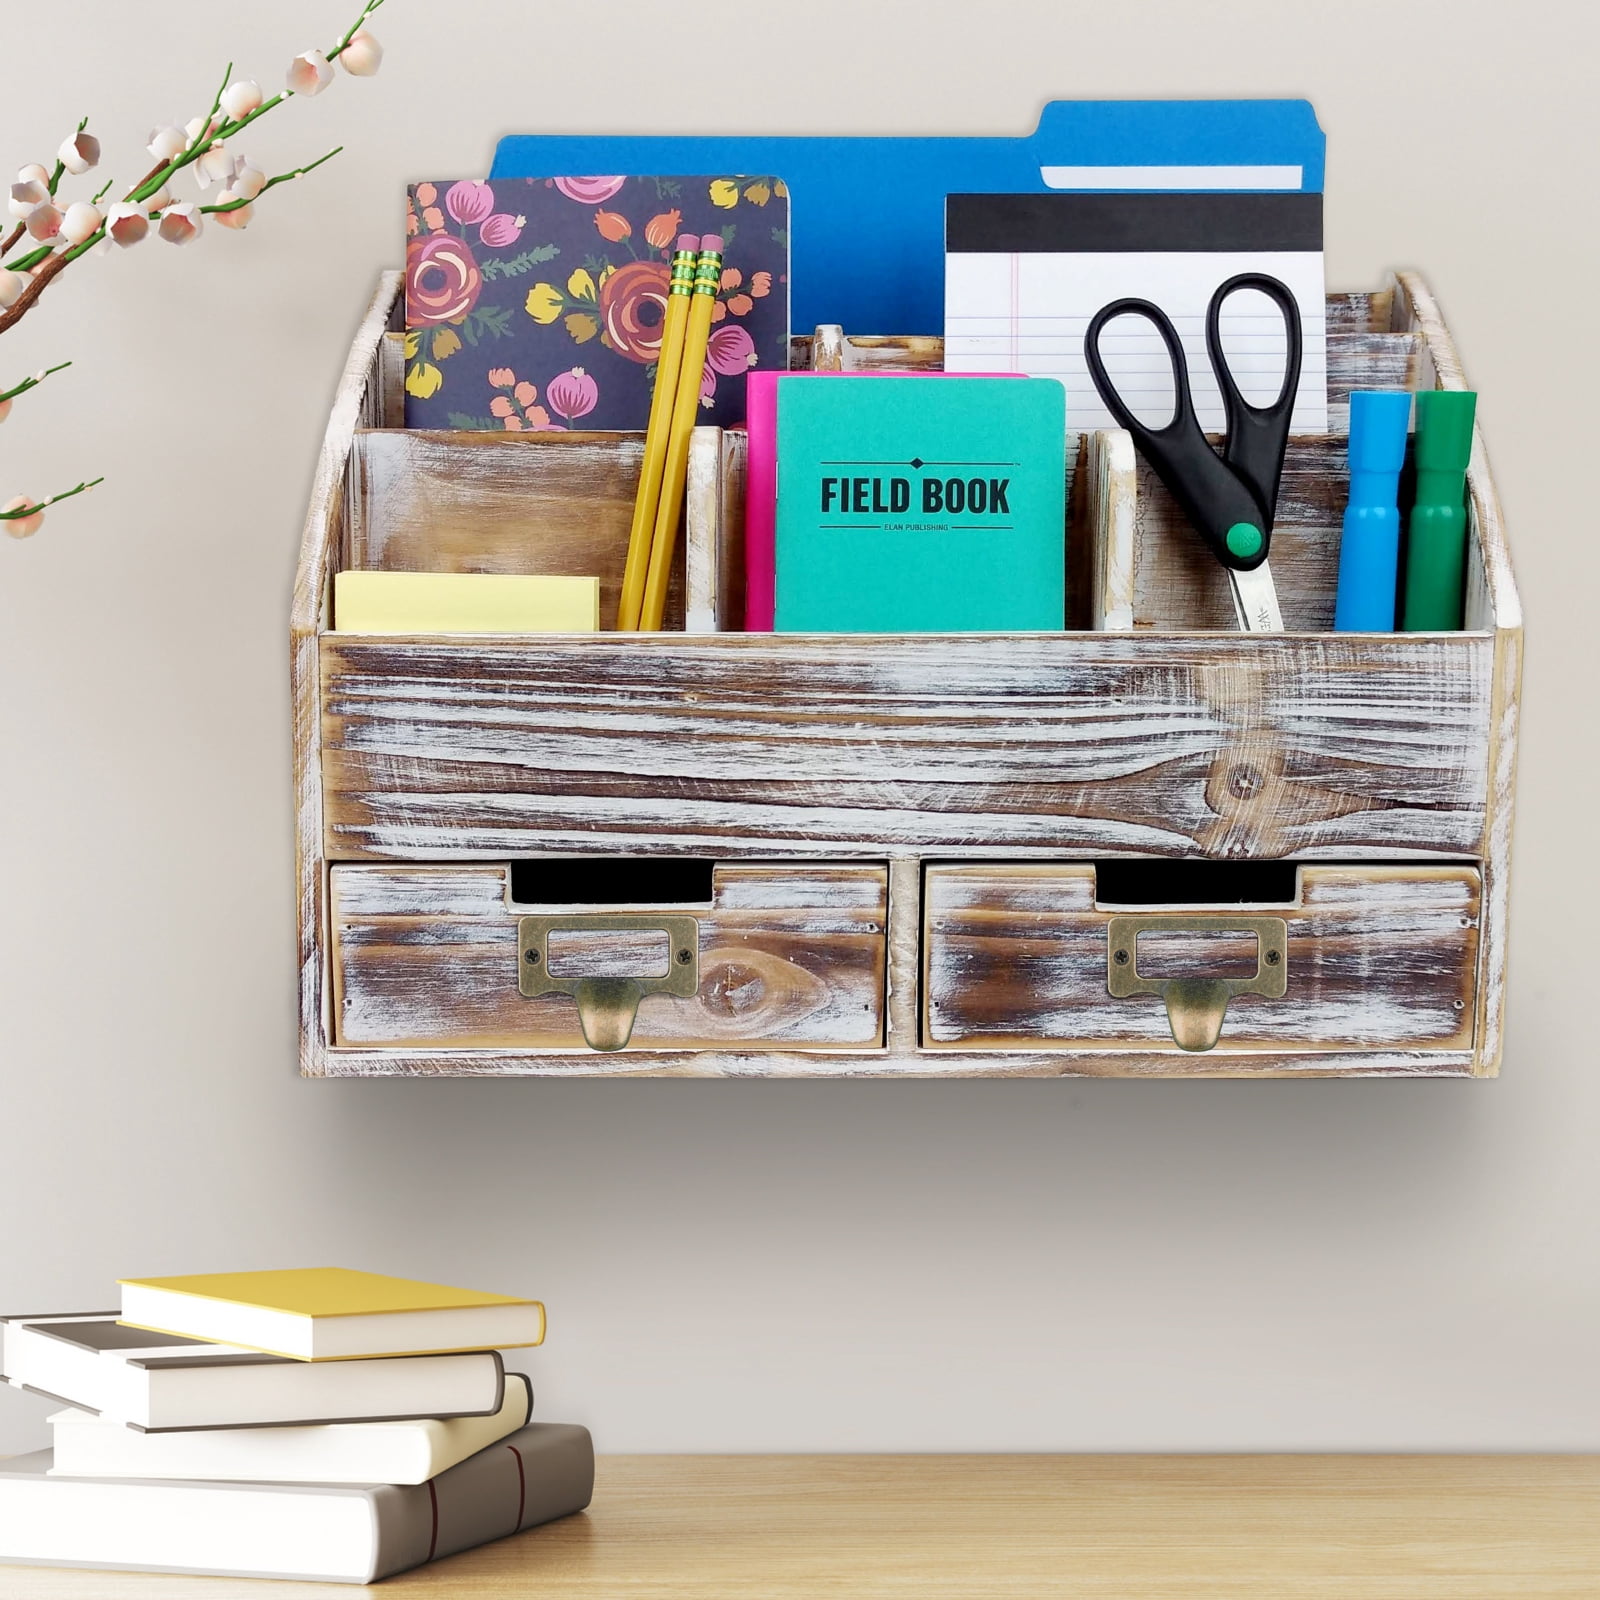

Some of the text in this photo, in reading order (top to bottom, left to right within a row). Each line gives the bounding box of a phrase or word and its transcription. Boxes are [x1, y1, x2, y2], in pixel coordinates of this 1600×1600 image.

[820, 477, 1010, 514] FIELD BOOK
[884, 523, 949, 531] ELAN PUBLISHING
